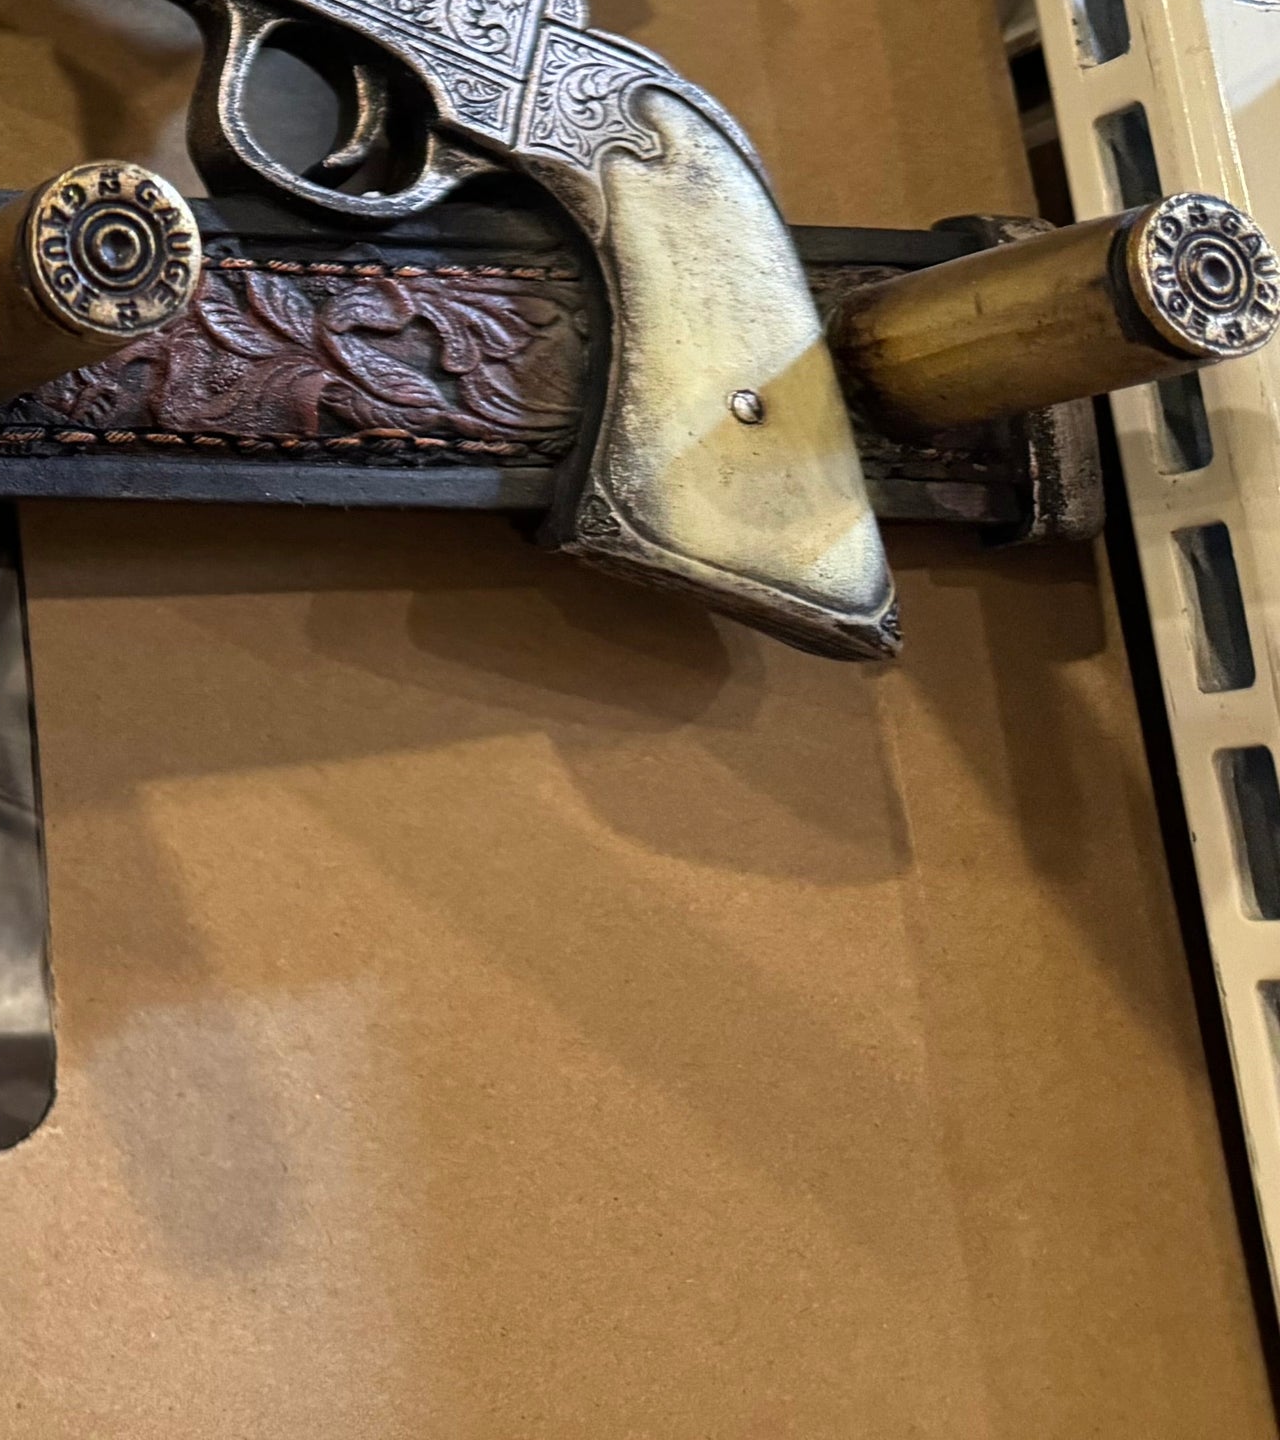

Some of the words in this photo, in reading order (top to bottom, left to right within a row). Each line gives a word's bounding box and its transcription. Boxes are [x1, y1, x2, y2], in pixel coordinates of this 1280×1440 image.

[40, 182, 100, 312] GAUGE
[98, 167, 121, 196] 12
[134, 179, 193, 311] GAUGE
